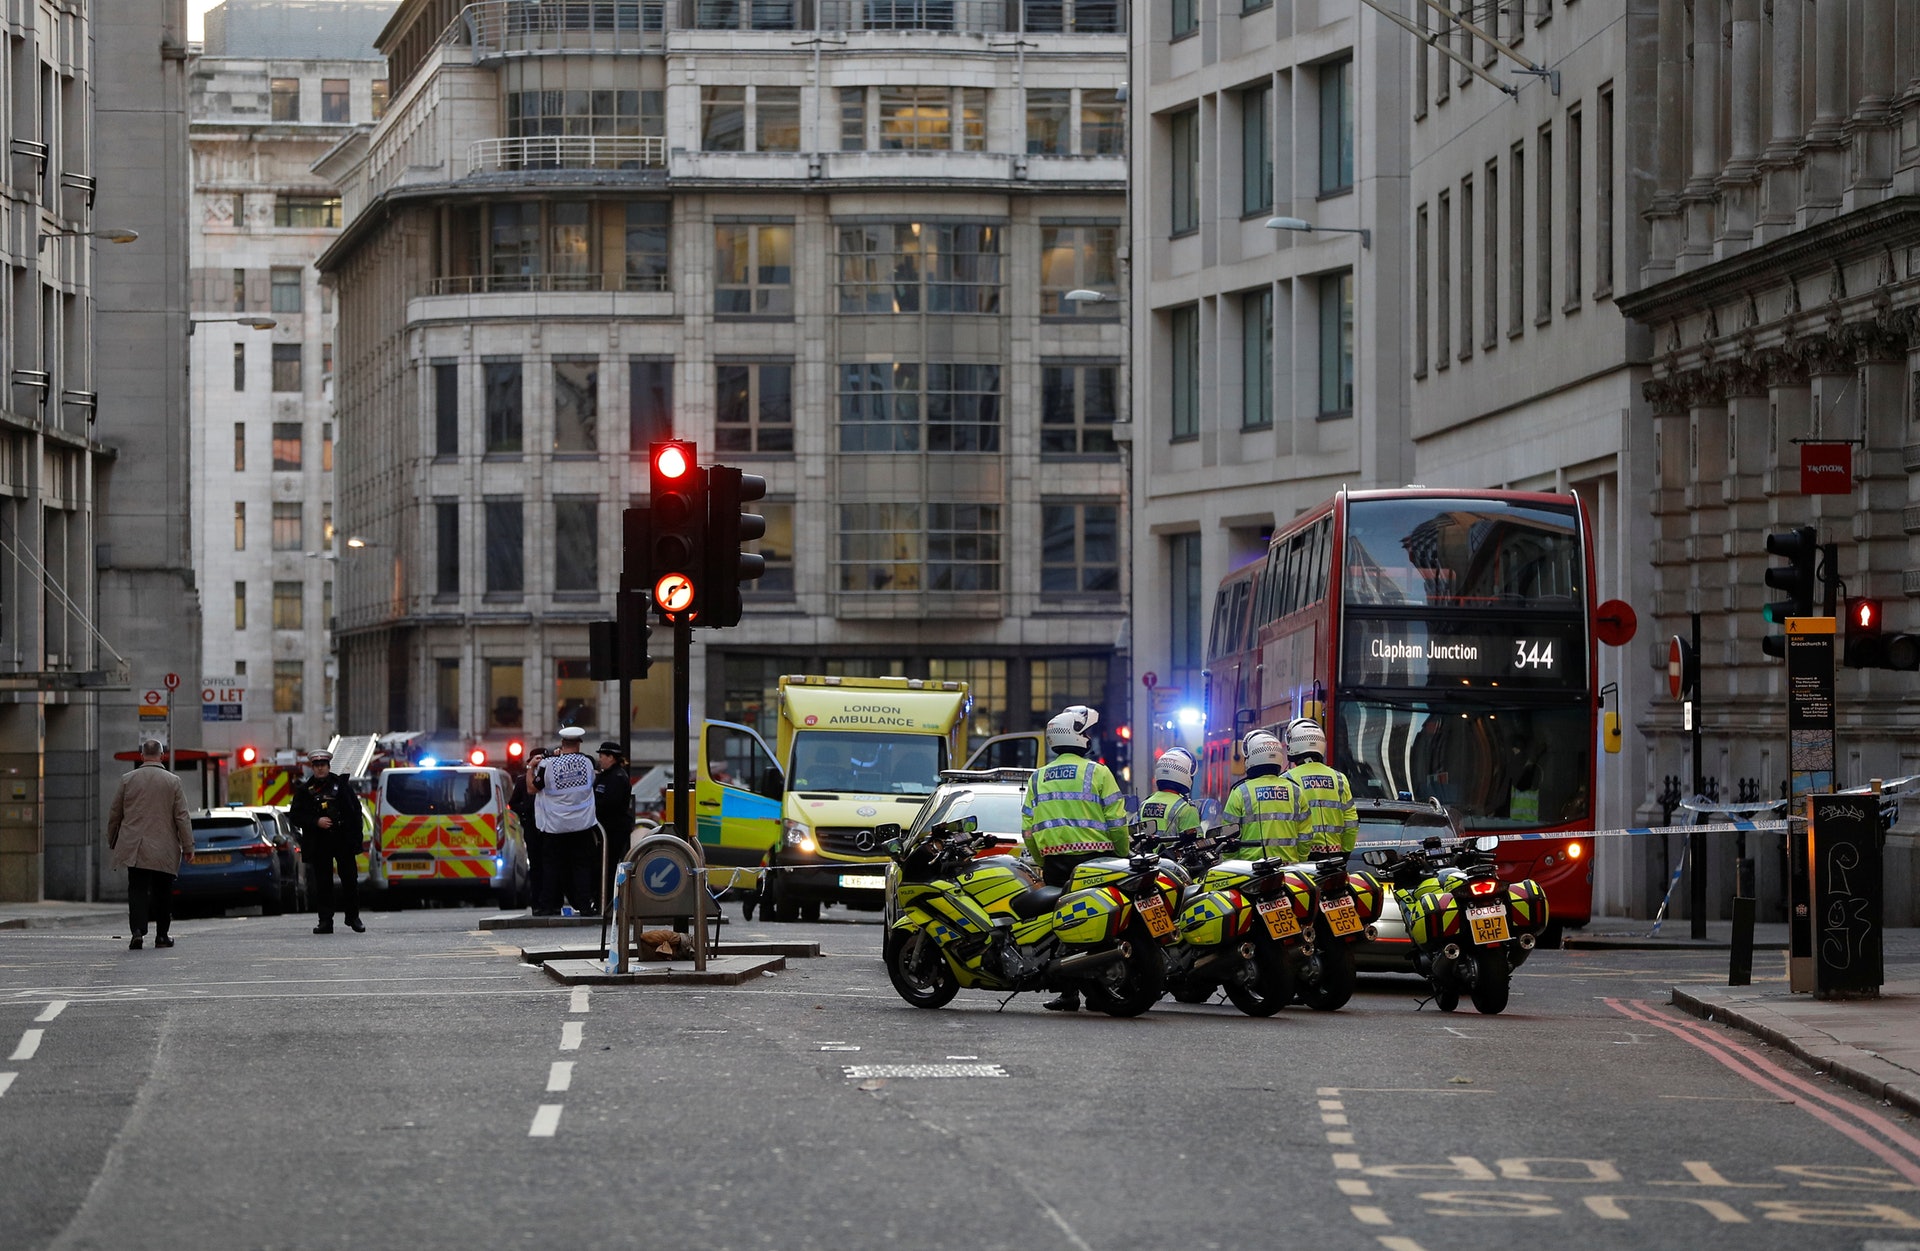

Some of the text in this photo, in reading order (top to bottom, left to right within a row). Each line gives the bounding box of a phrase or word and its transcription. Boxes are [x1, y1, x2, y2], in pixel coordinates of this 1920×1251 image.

[1371, 639, 1554, 669] Clapham Junction 344
[202, 678, 235, 686] OFFICES
[202, 688, 245, 702] O LET
[844, 705, 901, 714] LONDON
[829, 715, 915, 727] AMBULANCE
[557, 762, 581, 774] POLICE
[1045, 769, 1075, 781] POLICE
[1303, 780, 1333, 789] POLICE
[1256, 791, 1288, 800] POLICE
[1143, 808, 1164, 817] POLICE
[395, 836, 428, 846] POLICE
[1083, 877, 1104, 885] POLICE
[1212, 880, 1229, 888] POLICE
[1137, 897, 1161, 910] POLICE
[1260, 898, 1288, 912] POLICE
[1322, 898, 1351, 910] POLICE
[1143, 907, 1167, 922] LJ65
[1267, 909, 1293, 924] LJ65
[1328, 907, 1356, 922] LJ65
[1470, 906, 1501, 916] POLICE
[1152, 919, 1170, 932] GGV
[1273, 920, 1296, 934] GGX
[1335, 918, 1356, 932] GGY
[1475, 917, 1502, 930] LB17
